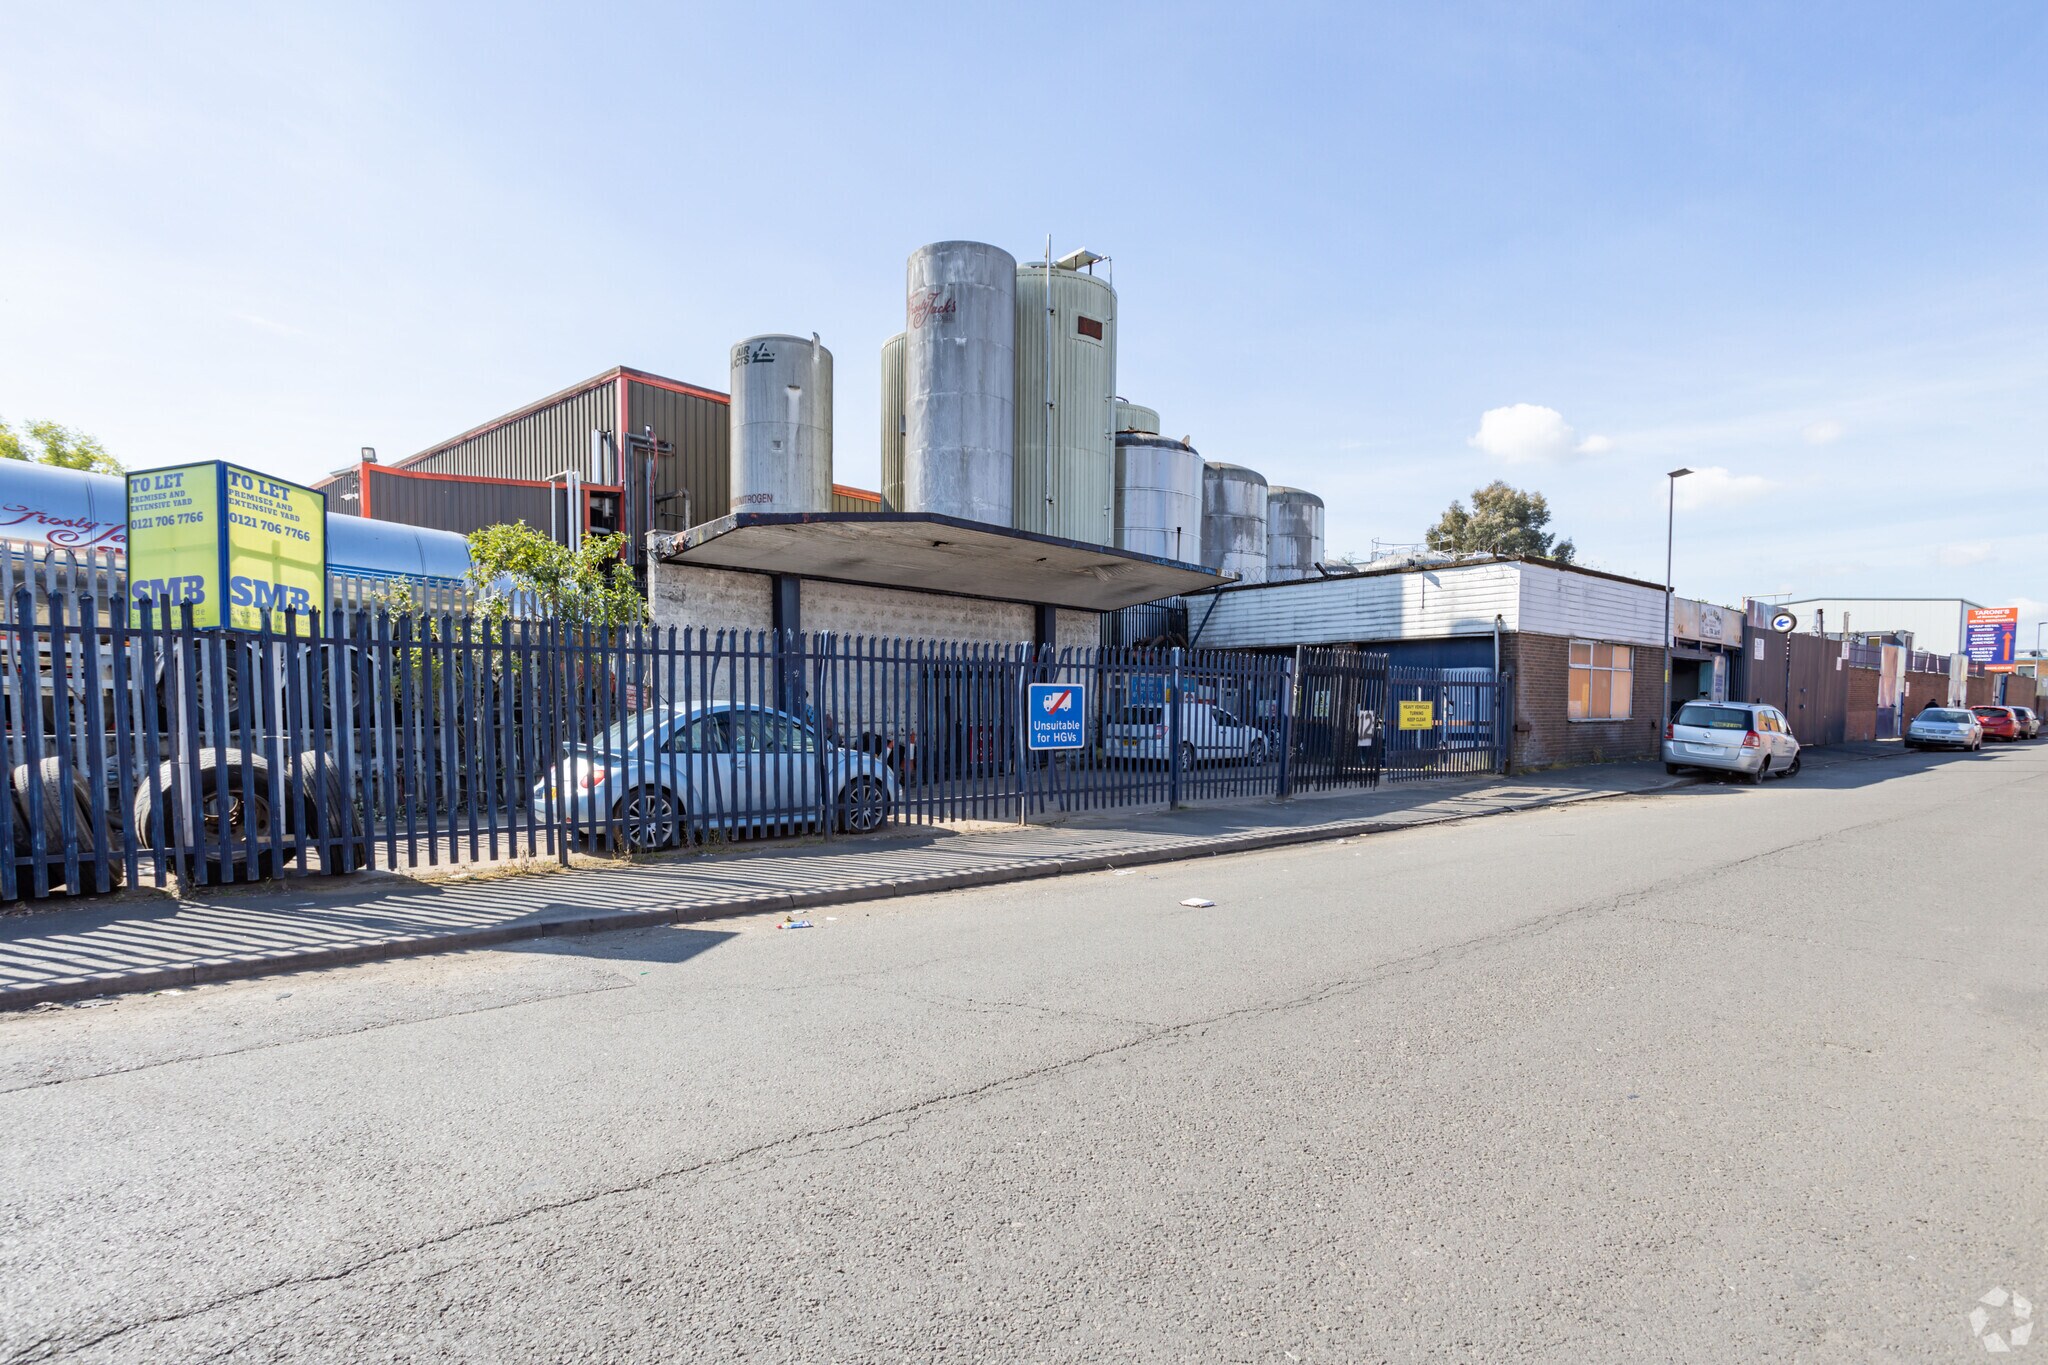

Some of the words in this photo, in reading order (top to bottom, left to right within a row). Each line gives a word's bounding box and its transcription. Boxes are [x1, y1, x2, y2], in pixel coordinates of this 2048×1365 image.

[736, 345, 750, 358] AIR
[130, 477, 151, 493] TO
[154, 472, 184, 491] LET
[228, 470, 254, 491] TO
[258, 480, 291, 502] LET
[130, 493, 168, 504] PREMISES
[169, 490, 186, 499] AND
[130, 501, 171, 513] EXTENSIVE
[173, 498, 193, 507] YARD
[228, 488, 273, 507] PREMISES
[276, 501, 293, 512] AND
[739, 493, 773, 505] NITROGEN
[131, 518, 153, 530] 0121
[155, 514, 175, 527] 706
[177, 511, 204, 524] 7766
[228, 498, 278, 516] EXTENSIVE
[280, 511, 300, 523] YARD
[229, 512, 257, 529] 0121
[260, 519, 282, 535] 706
[284, 526, 310, 542] 7766
[132, 575, 205, 611] SMB
[230, 575, 310, 616] SMB
[1034, 720, 1080, 731] Unsuitable
[1360, 713, 1374, 740] 12
[1037, 732, 1050, 743] for
[1053, 732, 1077, 742] HGVs
